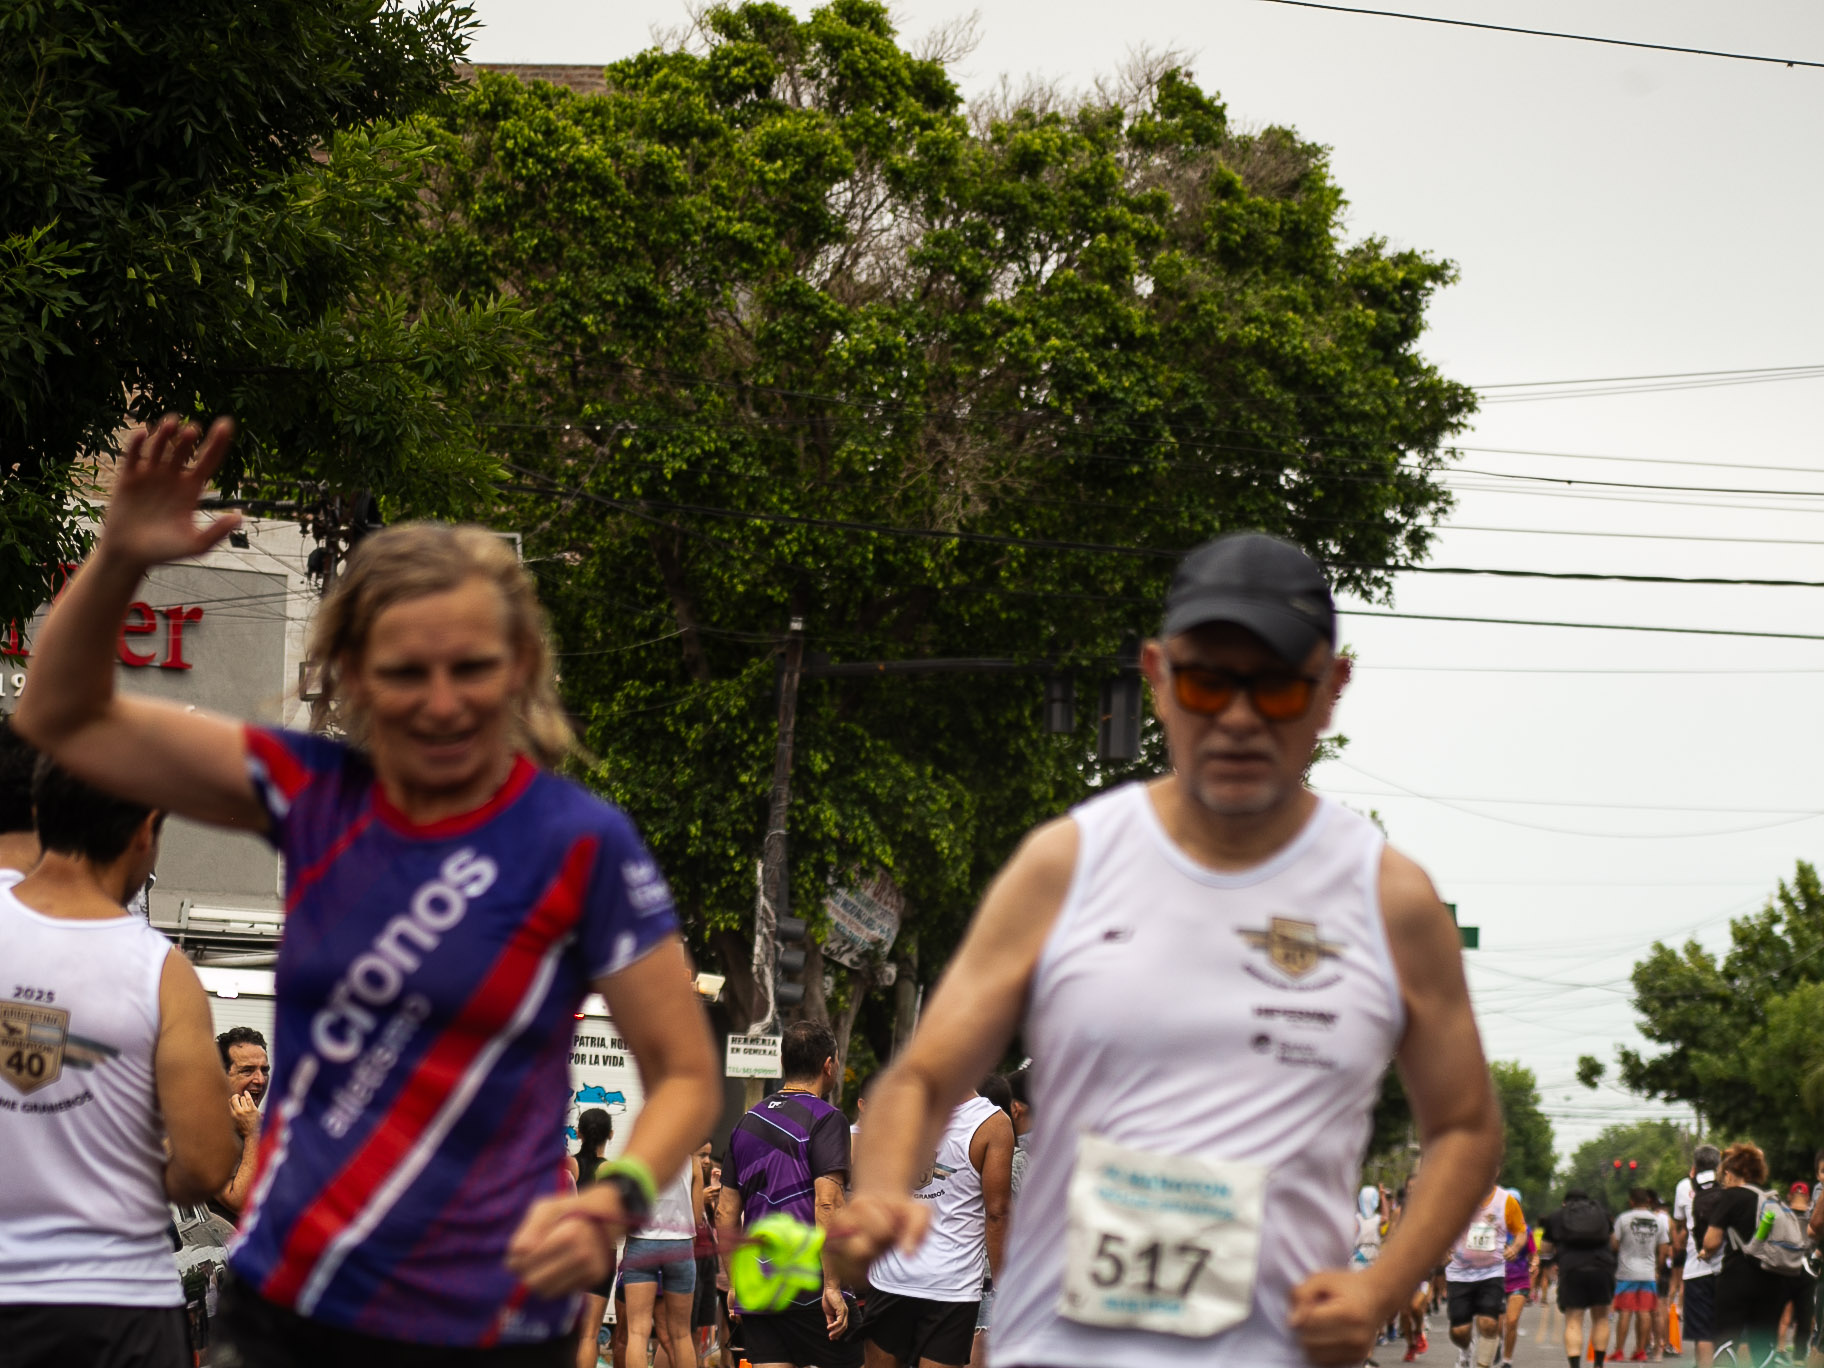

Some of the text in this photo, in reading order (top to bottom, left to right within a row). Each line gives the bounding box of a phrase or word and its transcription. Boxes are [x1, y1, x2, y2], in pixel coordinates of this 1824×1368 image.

[310, 847, 498, 1063] cronos
[13, 986, 56, 1003] 2025
[573, 1034, 609, 1050] PATRIA,
[6, 1050, 46, 1078] 40
[568, 1052, 625, 1068] POR LA VIDA
[1089, 1230, 1212, 1301] 517
